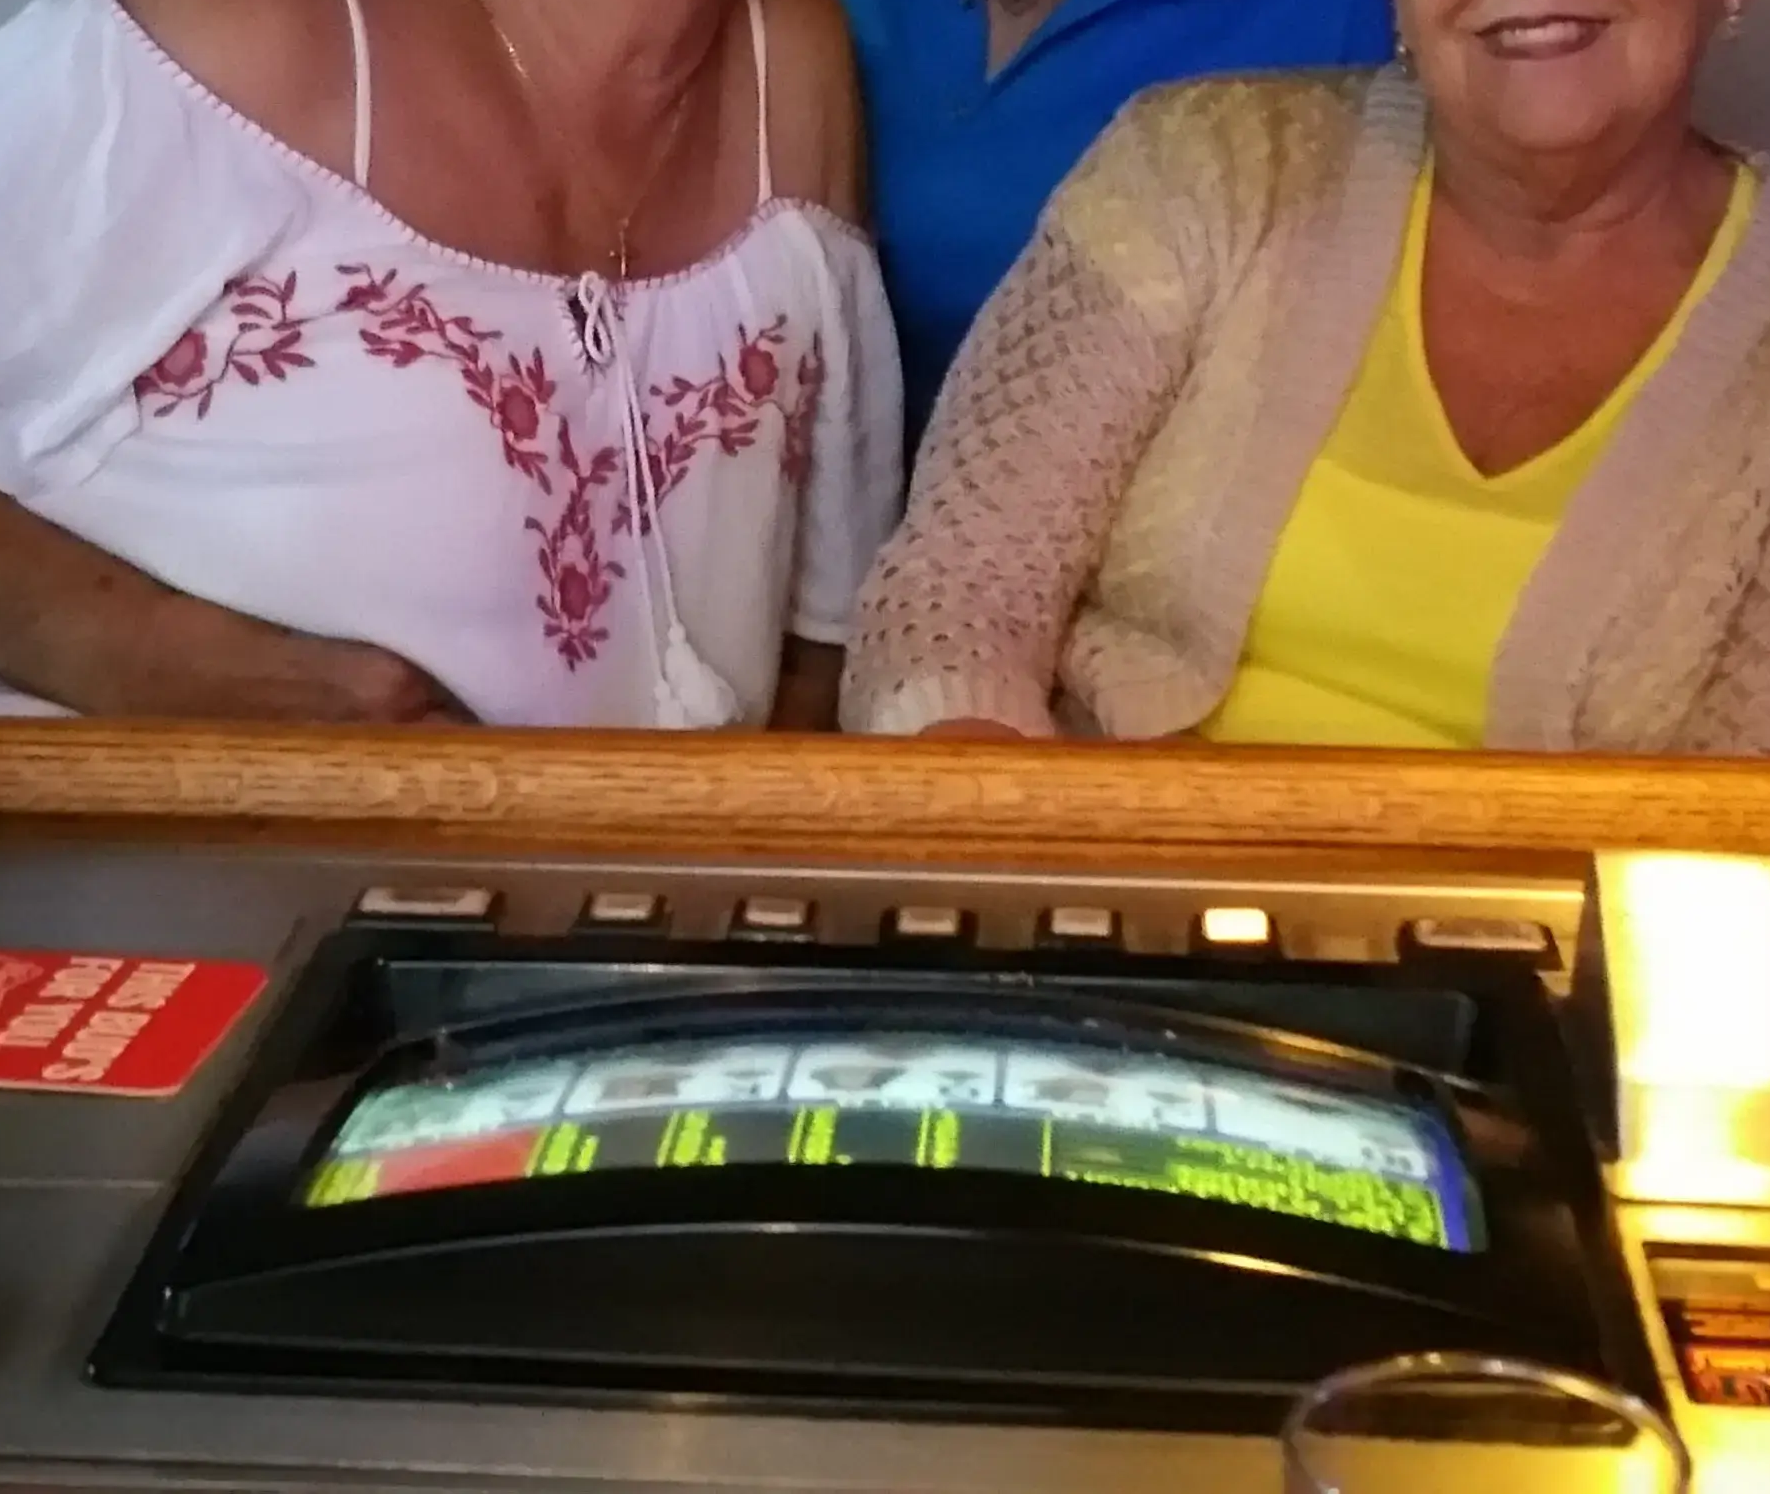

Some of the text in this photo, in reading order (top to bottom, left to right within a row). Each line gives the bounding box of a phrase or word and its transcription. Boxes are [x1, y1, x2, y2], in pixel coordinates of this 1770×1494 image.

[38, 956, 125, 999] FOR
[41, 961, 196, 1082] THIS BUD'S
